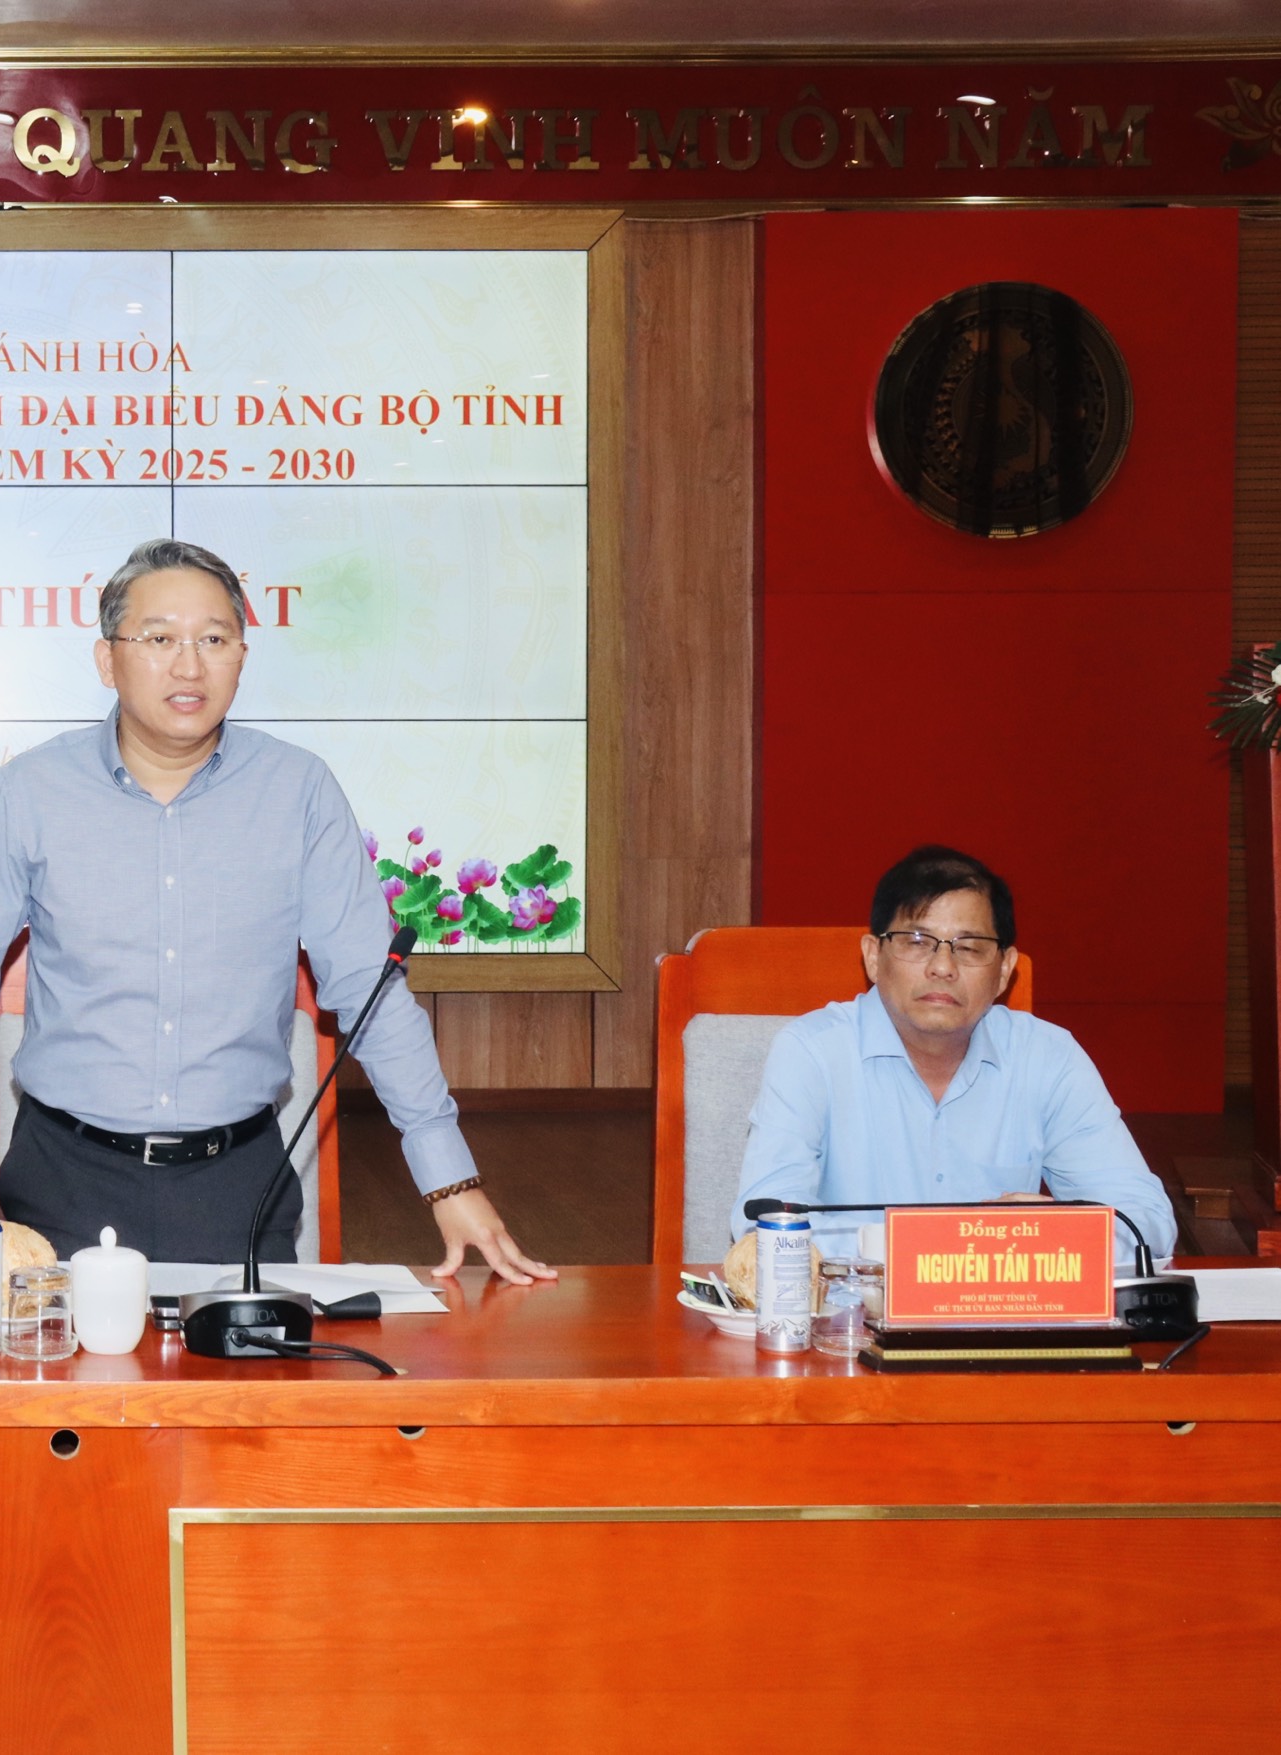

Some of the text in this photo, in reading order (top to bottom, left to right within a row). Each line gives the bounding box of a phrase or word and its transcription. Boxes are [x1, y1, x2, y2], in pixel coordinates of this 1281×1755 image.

[12, 107, 338, 177] QUANG
[365, 107, 600, 171] VINH
[627, 85, 912, 172] MUÔN
[934, 84, 1153, 170] NĂM
[97, 332, 192, 373] HÒA
[20, 396, 96, 436] ĐẠI
[111, 385, 221, 428] BIỂU
[236, 385, 364, 427] ĐẢNG
[379, 389, 441, 436] BỘ
[454, 385, 565, 427] TỈNH
[62, 439, 126, 481] KỲ
[140, 449, 229, 482] 2025
[268, 449, 356, 482] 2030
[773, 1236, 810, 1249] Alkalin
[959, 1220, 1040, 1240] Đồng chí
[917, 1244, 1081, 1283] NGUYỄN TẤN TUÂN
[252, 1309, 279, 1322] TOA
[1152, 1292, 1178, 1304] TOA
